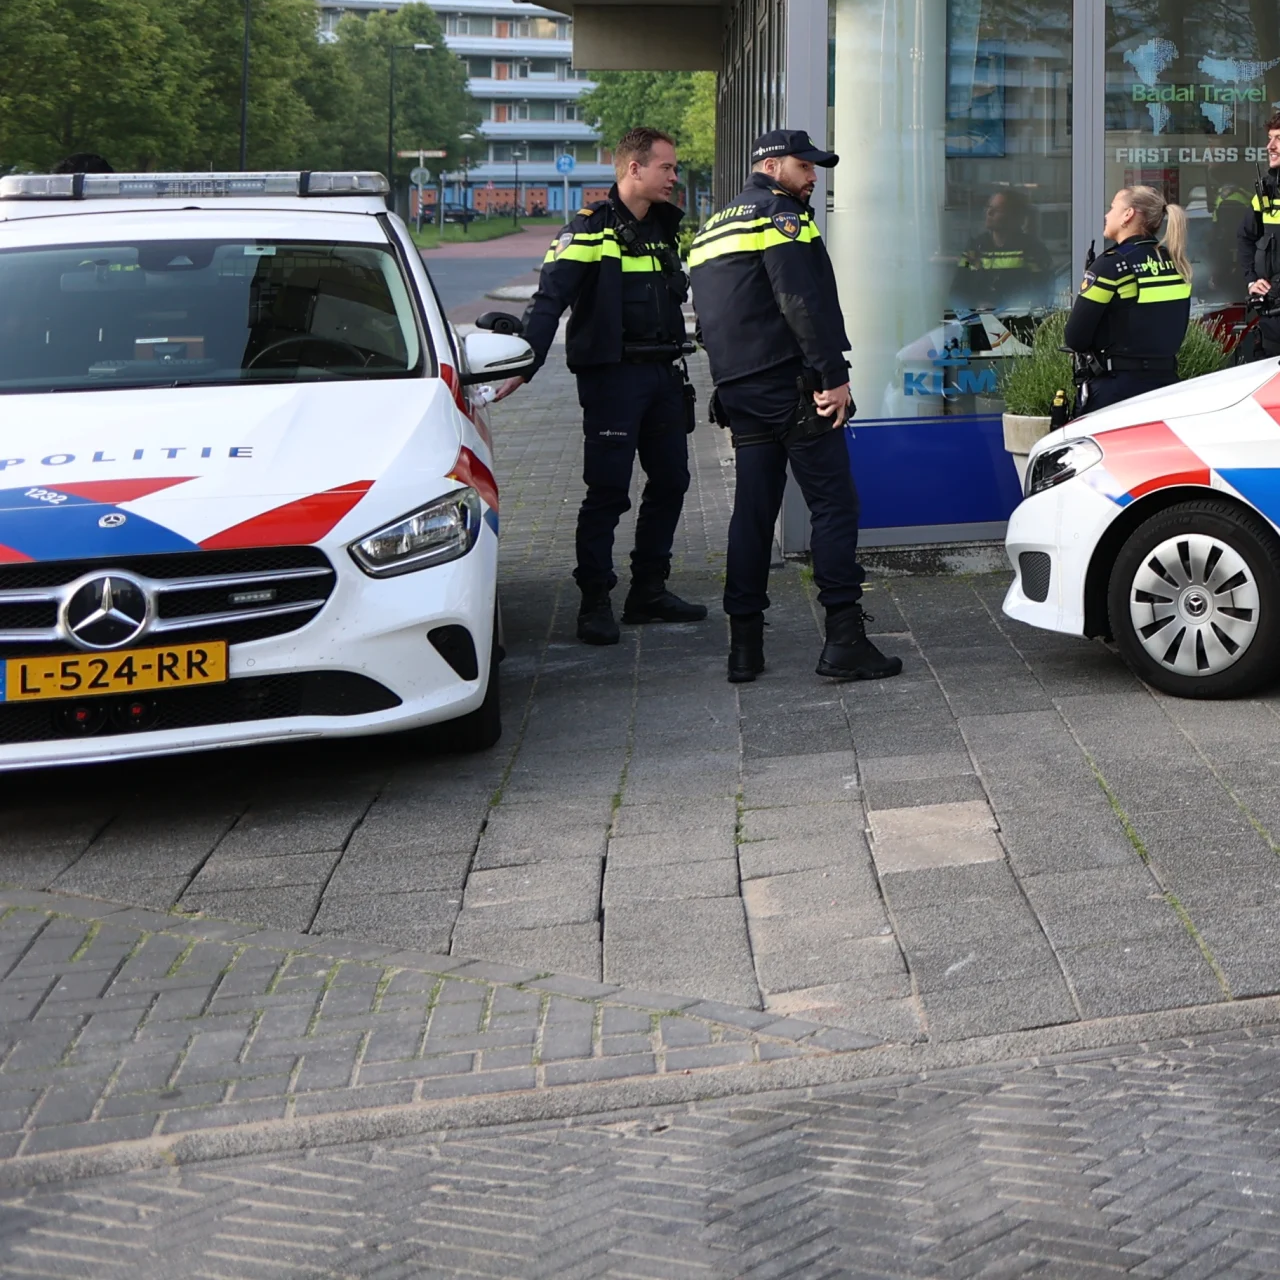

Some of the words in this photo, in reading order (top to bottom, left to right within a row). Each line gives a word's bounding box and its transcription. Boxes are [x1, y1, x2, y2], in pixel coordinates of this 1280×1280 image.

[1132, 84, 1195, 102] Badal
[1200, 84, 1267, 102] Travel
[1115, 147, 1172, 164] FIRST
[1178, 146, 1239, 163] CLASS
[1141, 260, 1176, 276] POLIT
[903, 368, 997, 396] KLM
[0, 446, 254, 470] POLITIE
[24, 487, 68, 505] 1232
[19, 648, 210, 695] L-524-RR
